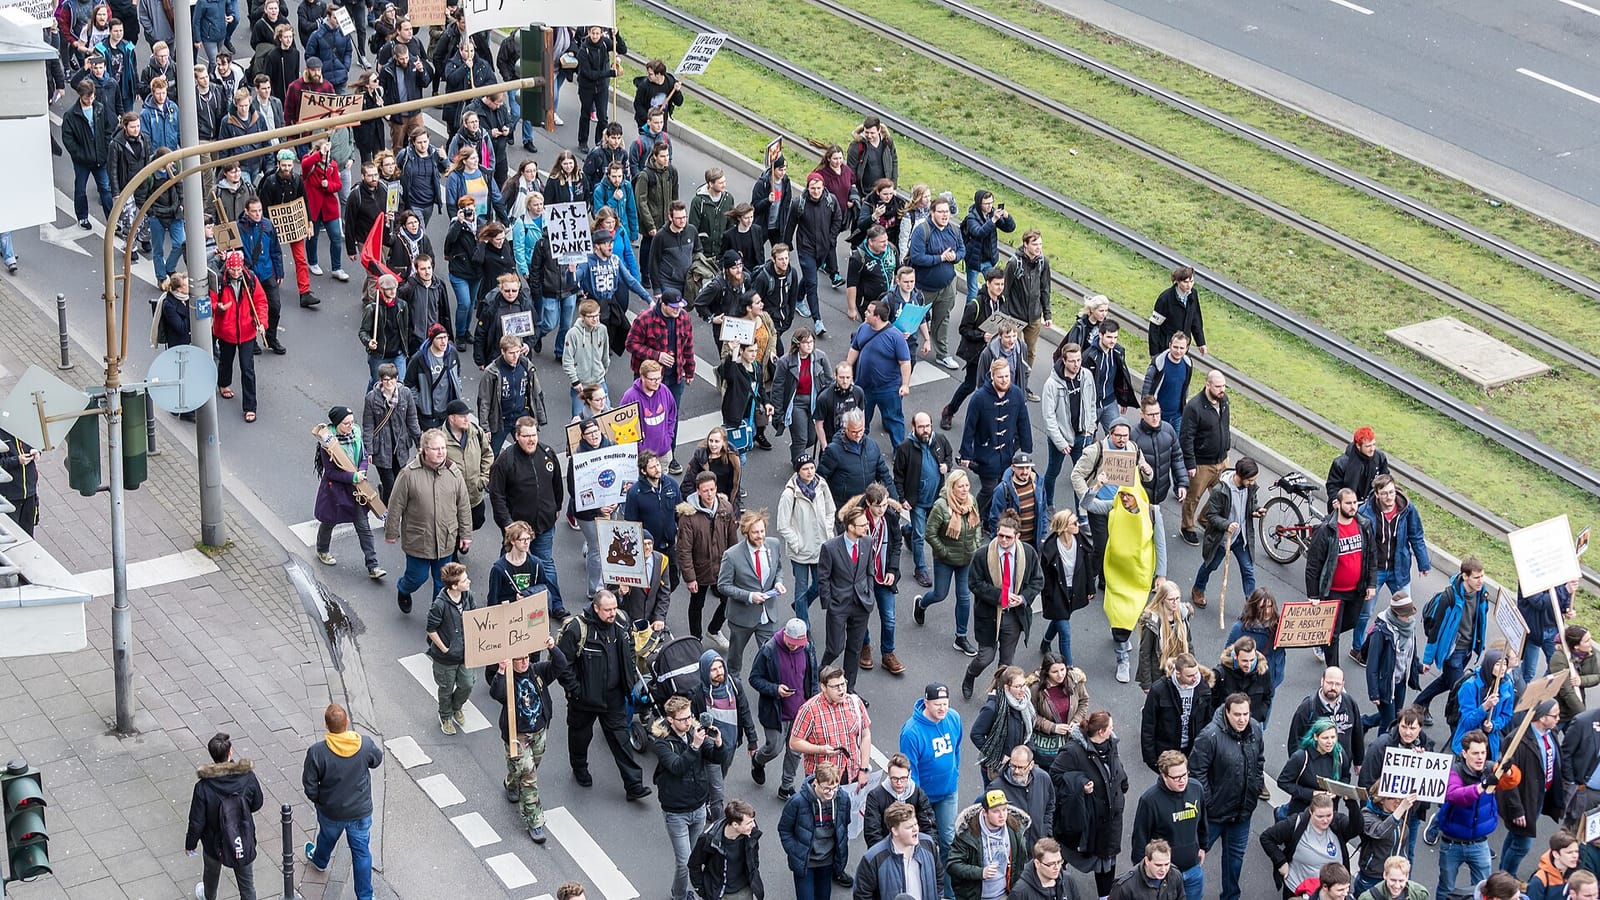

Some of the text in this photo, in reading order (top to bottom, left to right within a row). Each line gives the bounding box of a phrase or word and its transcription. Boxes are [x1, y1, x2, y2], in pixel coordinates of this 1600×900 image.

[695, 35, 723, 46] UPLOAD
[690, 45, 716, 55] FILTER
[680, 61, 704, 72] SATIRE
[307, 94, 359, 107] ARTIKEL
[550, 204, 586, 221] Art.
[558, 218, 577, 231] 13
[551, 230, 587, 241] NEIN
[552, 240, 592, 254] DANKE
[595, 274, 614, 292] 86
[614, 408, 637, 423] CDU:
[603, 451, 626, 460] endlich
[615, 575, 642, 585] PARTEI
[1323, 606, 1336, 615] HAT
[473, 607, 524, 632] Wir sind
[1284, 618, 1326, 630] DIE ABSICHT
[508, 628, 531, 646] Bots
[1279, 632, 1294, 642] ZU
[1384, 751, 1449, 771] RETTET DAS
[1380, 772, 1446, 798] NEULAND
[234, 836, 244, 859] FILA
